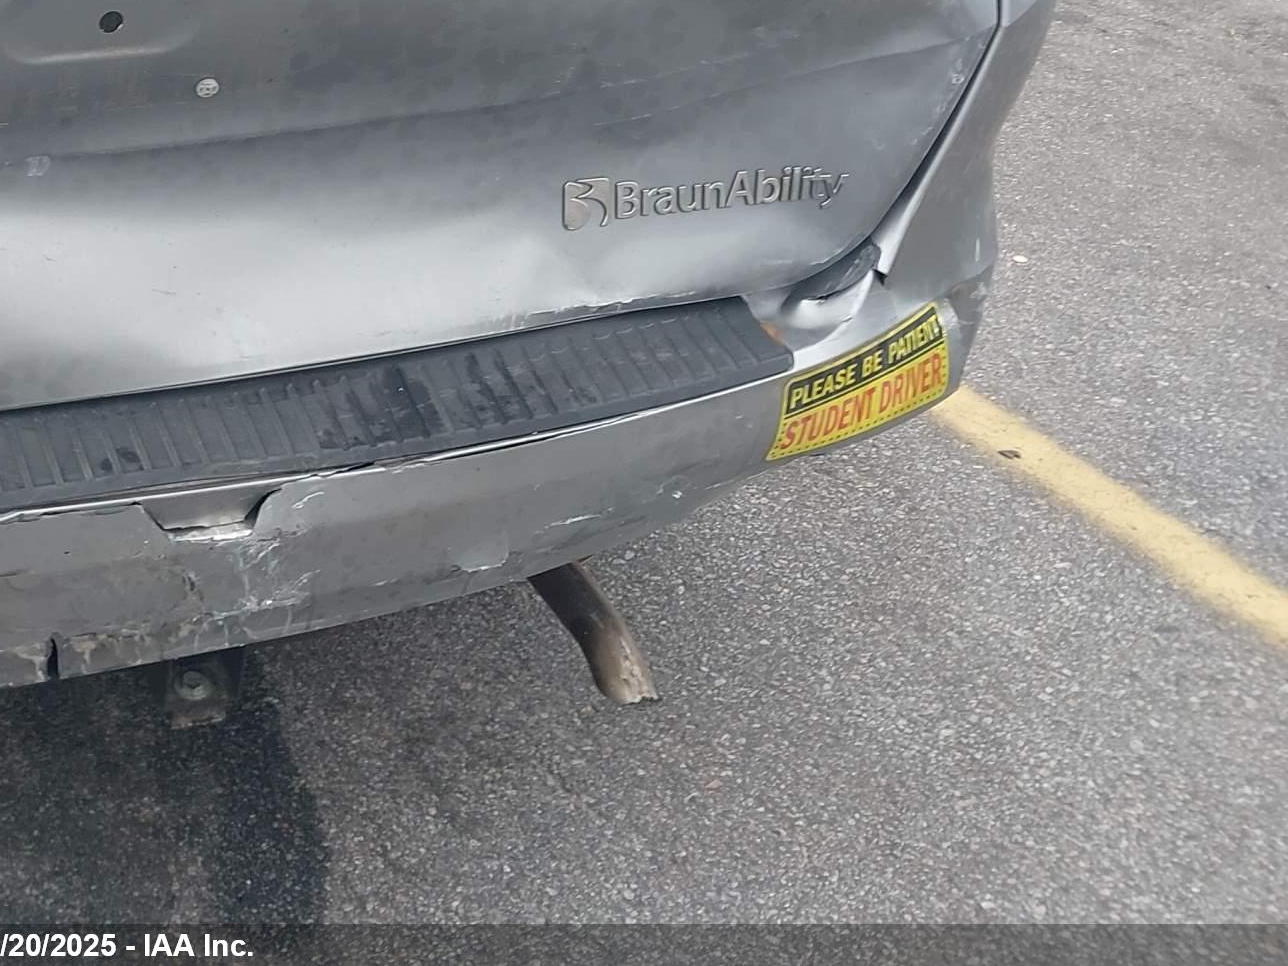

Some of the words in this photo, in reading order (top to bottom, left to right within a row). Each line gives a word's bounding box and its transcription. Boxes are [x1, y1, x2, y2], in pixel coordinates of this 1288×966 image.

[614, 166, 850, 220] BraunAbility
[780, 387, 877, 451] STUDENT
[879, 352, 943, 415] DRIVER
[789, 362, 858, 410] PLEASE
[862, 349, 884, 378] BE
